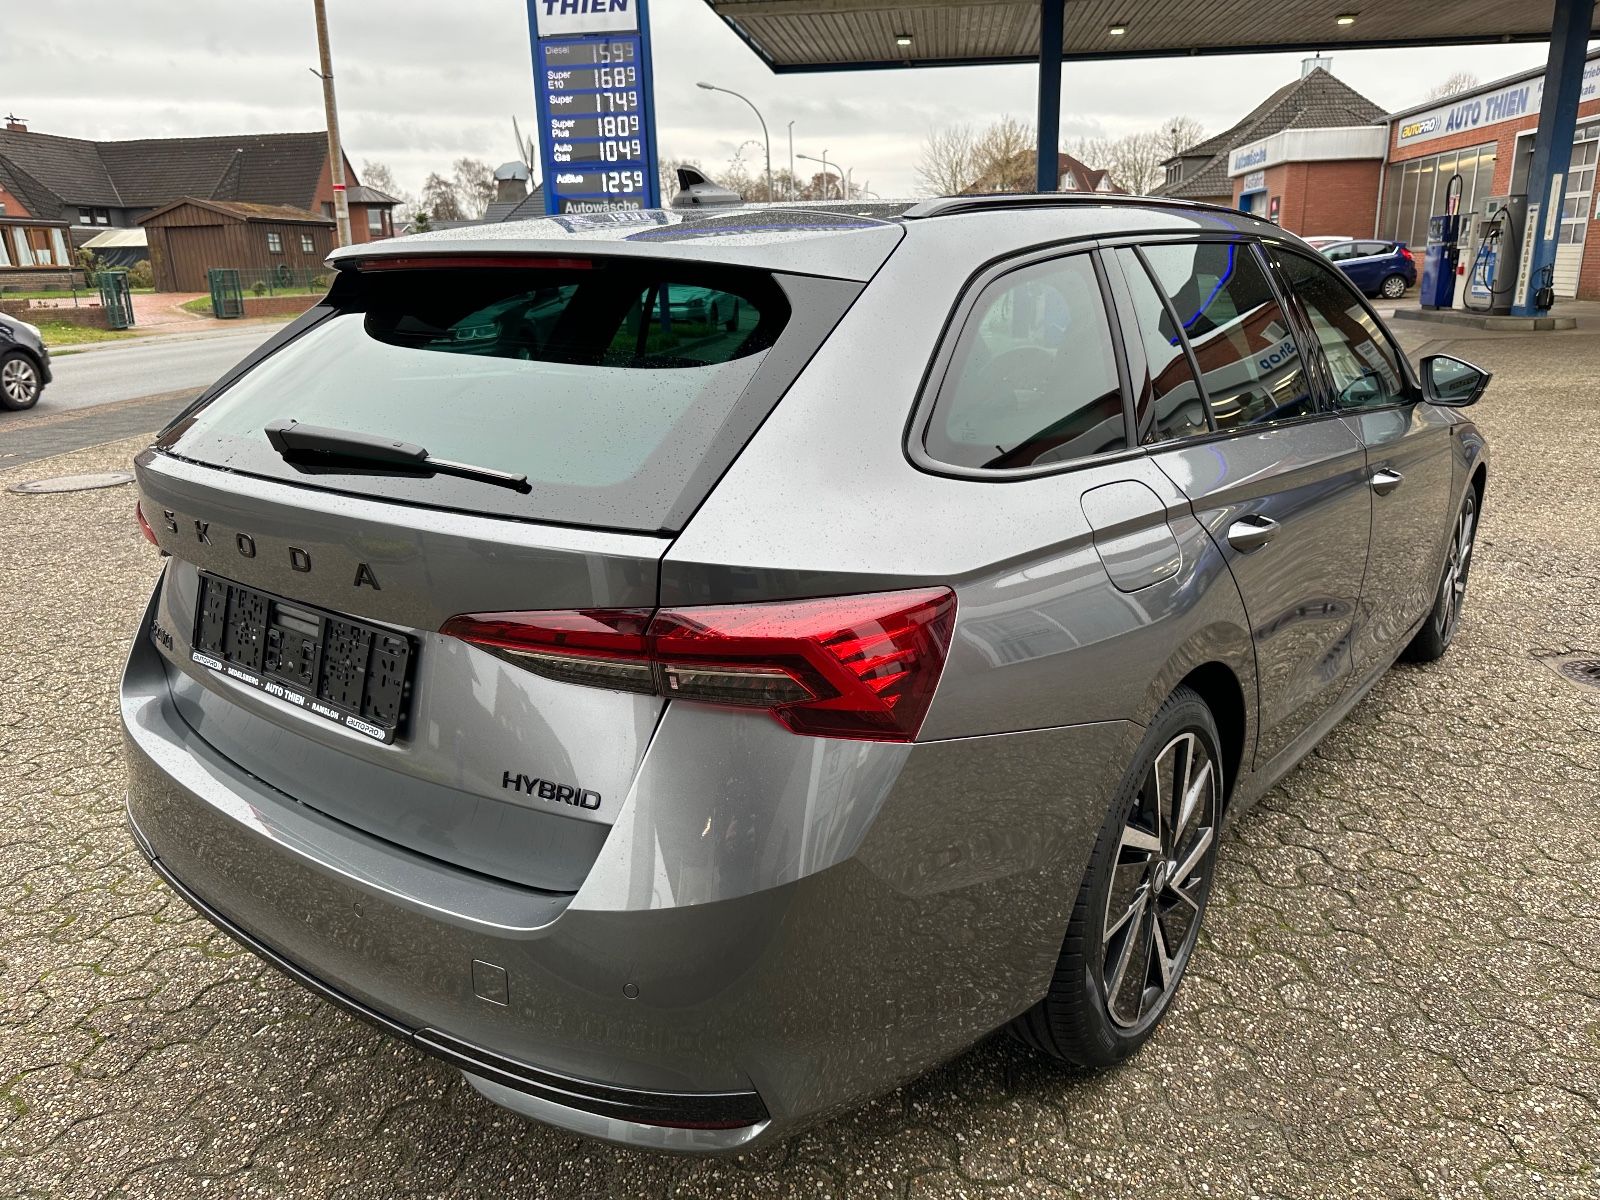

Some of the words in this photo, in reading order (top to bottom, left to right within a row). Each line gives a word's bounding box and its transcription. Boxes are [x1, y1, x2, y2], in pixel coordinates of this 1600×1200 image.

[542, 0, 627, 16] THIEN
[545, 46, 569, 54] Diesel
[547, 70, 571, 81] Super
[547, 80, 564, 89] E10
[549, 95, 573, 106] Super
[1446, 100, 1481, 132] AUTO
[1485, 87, 1529, 122] THIEN
[551, 119, 575, 129] Super
[551, 129, 569, 138] Plus
[554, 143, 572, 152] Auto
[554, 153, 570, 162] Gas
[556, 174, 583, 184] AdBlue
[565, 201, 639, 214] Autowäsche
[1517, 215, 1535, 303] TANKAUTOMAT
[227, 667, 259, 686] SEDELSBERG
[264, 682, 284, 697] AUTO
[284, 689, 305, 706] THIEN
[311, 702, 340, 720] RAMSLOH
[502, 770, 602, 811] HYBRID
